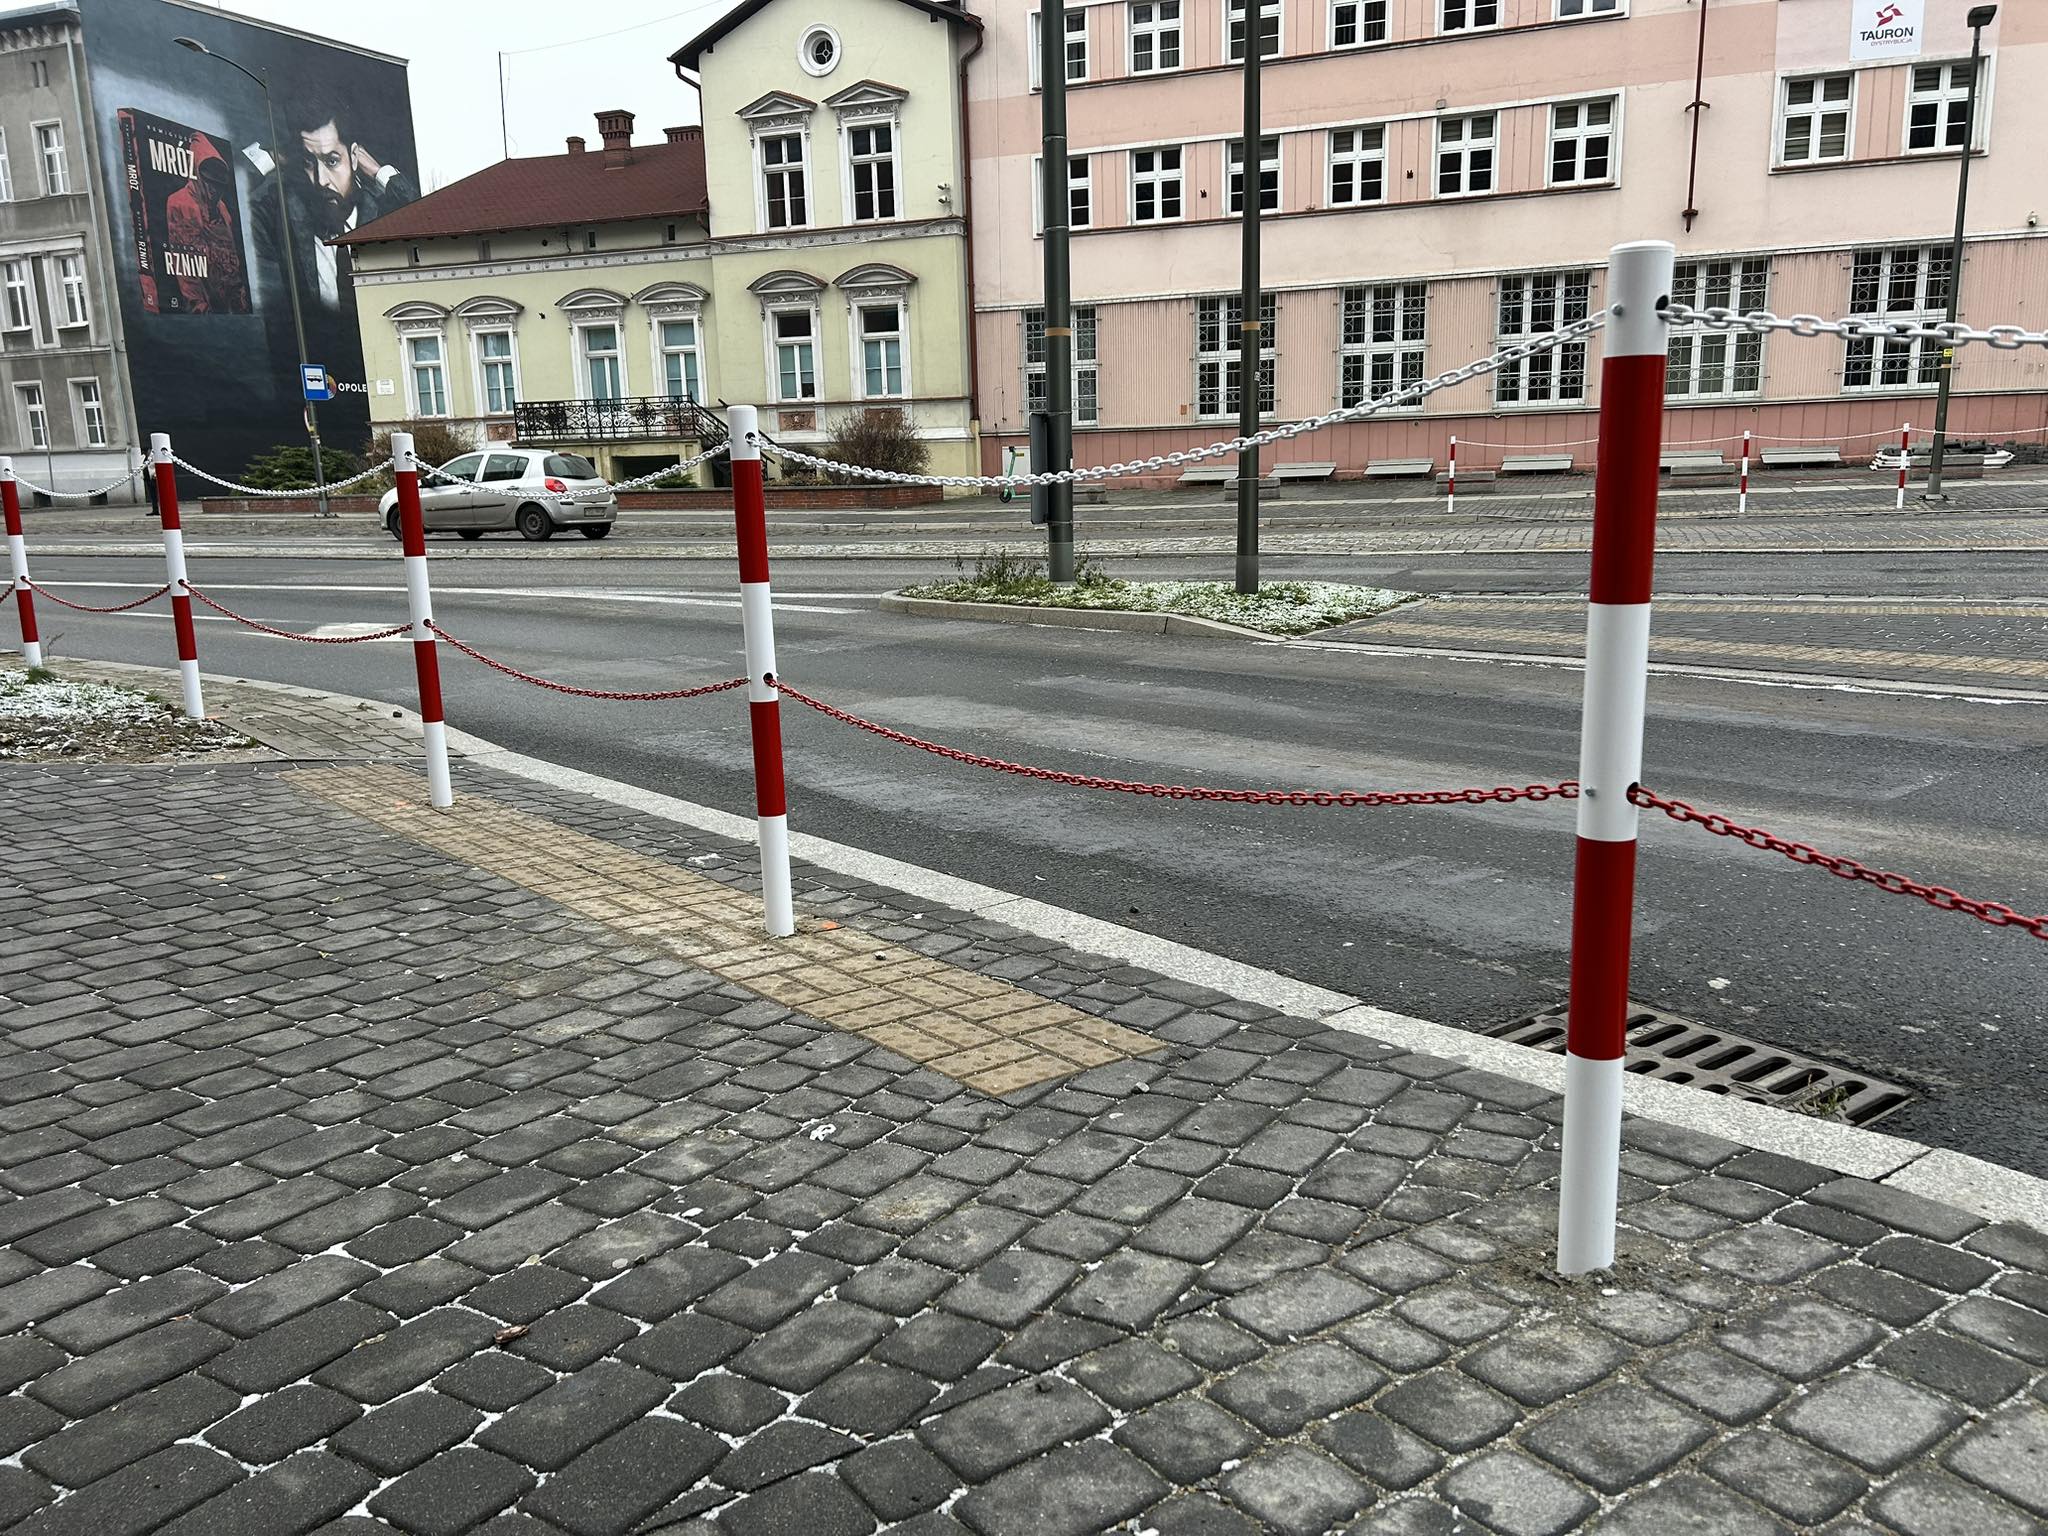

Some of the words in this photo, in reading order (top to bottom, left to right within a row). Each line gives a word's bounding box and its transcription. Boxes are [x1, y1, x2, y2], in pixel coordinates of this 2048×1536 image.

[1860, 27, 1913, 41] TAURON
[149, 141, 198, 180] MRÓZ
[127, 164, 139, 191] MRÓZ
[338, 382, 367, 393] OPOLE
